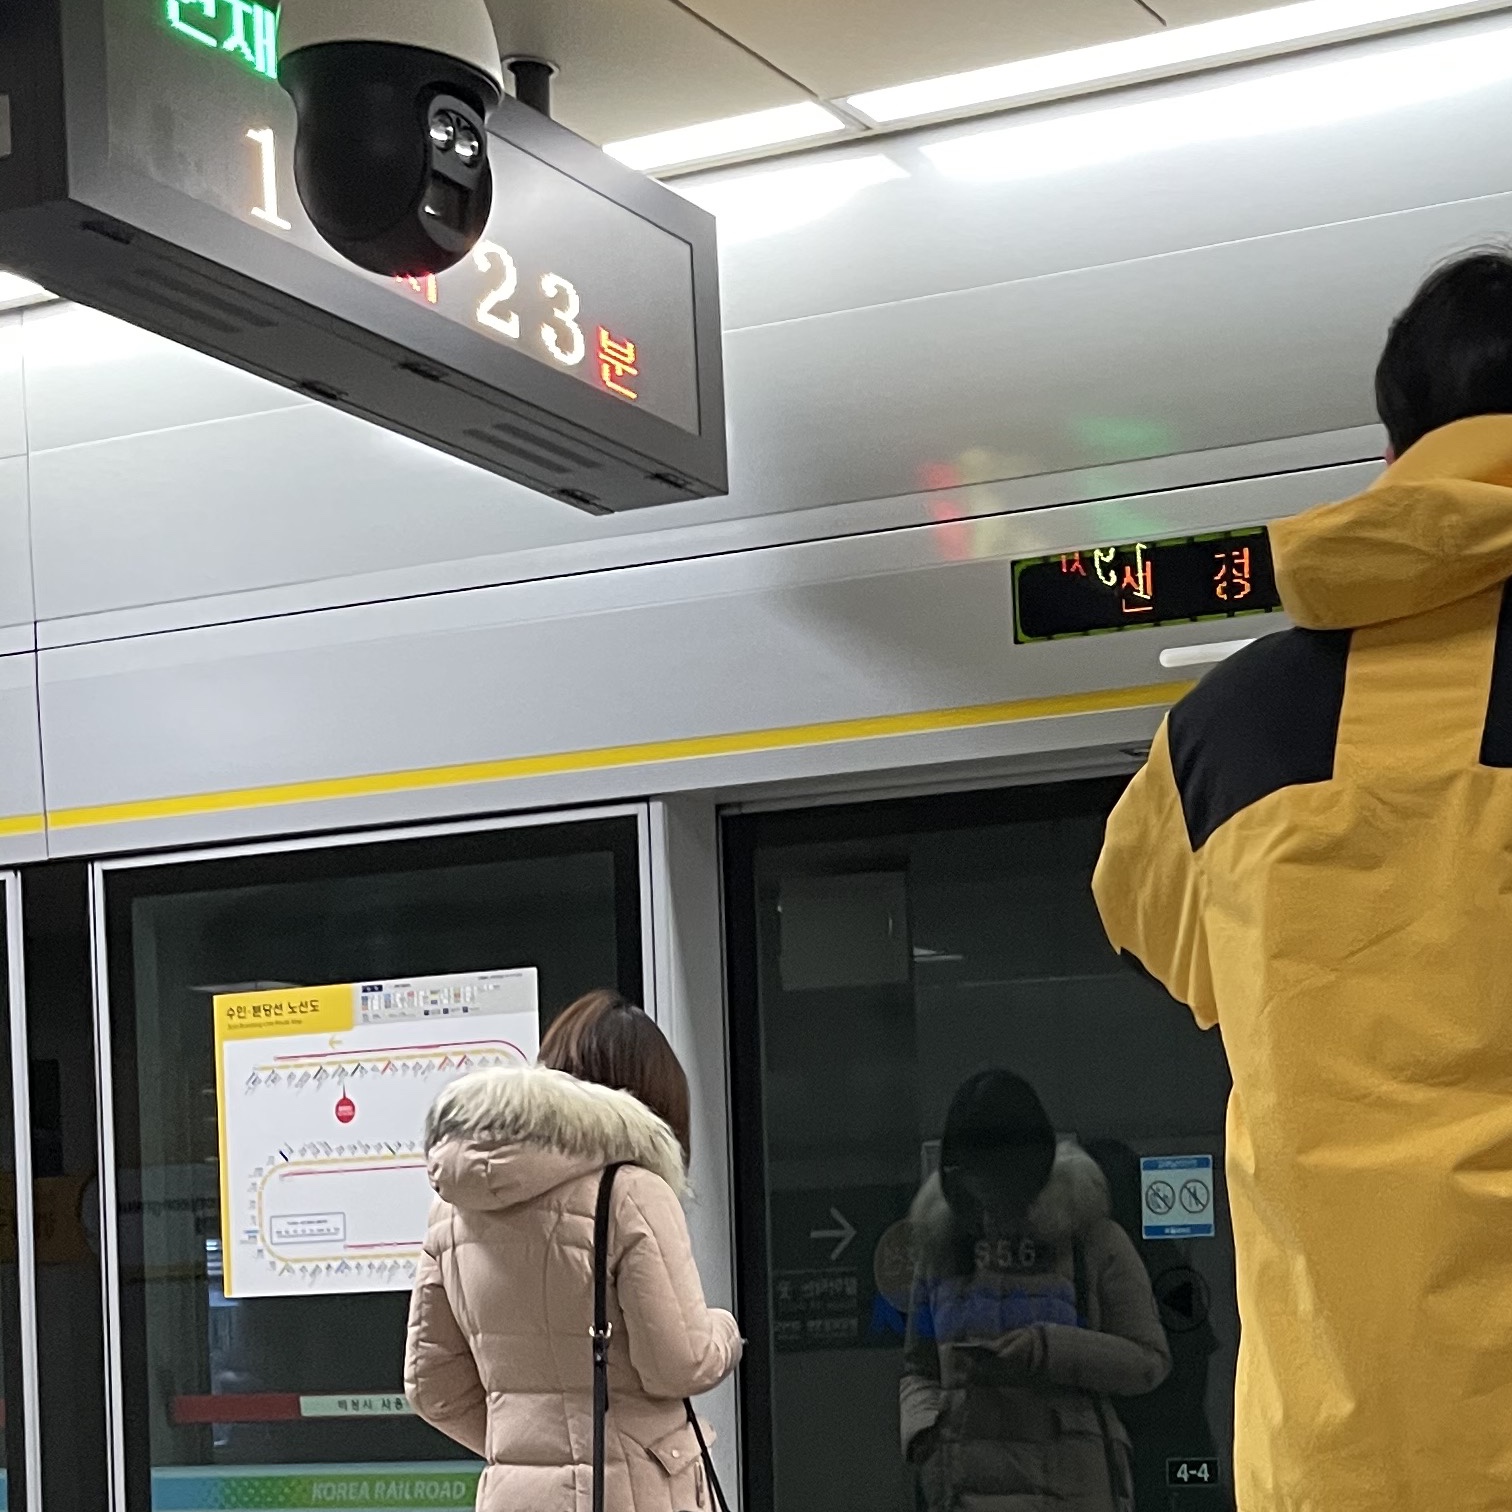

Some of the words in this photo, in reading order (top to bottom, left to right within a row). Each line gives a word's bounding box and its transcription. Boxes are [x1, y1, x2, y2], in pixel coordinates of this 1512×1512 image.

[287, 999, 320, 1015] 노선도
[1176, 1463, 1210, 1482] 4-4
[312, 1481, 370, 1501] KOREA
[374, 1480, 466, 1500] RAILROAD
